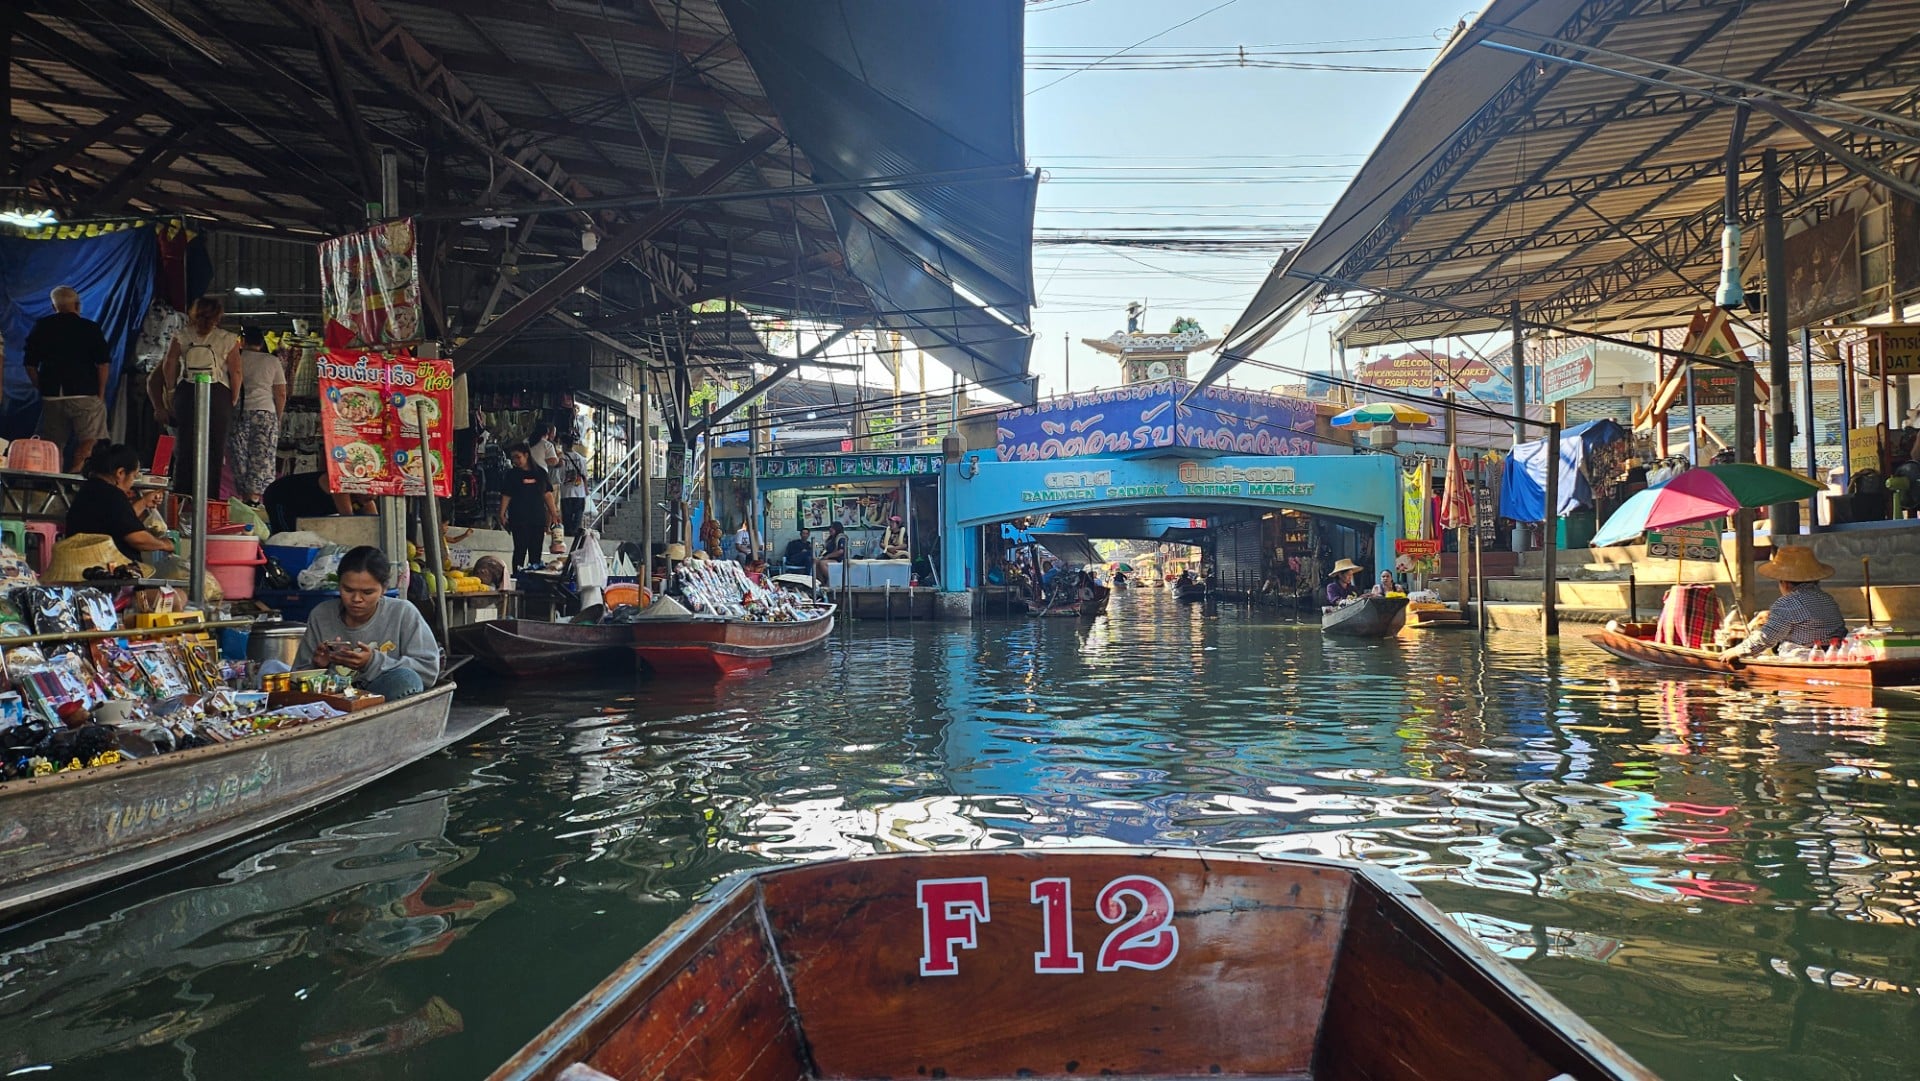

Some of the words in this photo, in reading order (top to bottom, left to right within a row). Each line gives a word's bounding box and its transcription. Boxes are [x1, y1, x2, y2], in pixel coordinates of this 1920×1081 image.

[997, 401, 1174, 462] ยินดีต้อนรับ
[1022, 487, 1096, 502] DAMNOEN
[1107, 484, 1168, 498] SADUAK
[1249, 483, 1315, 496] MARKET
[1044, 470, 1112, 489] ตลาด
[916, 876, 991, 976] F
[1030, 874, 1180, 974] 12
